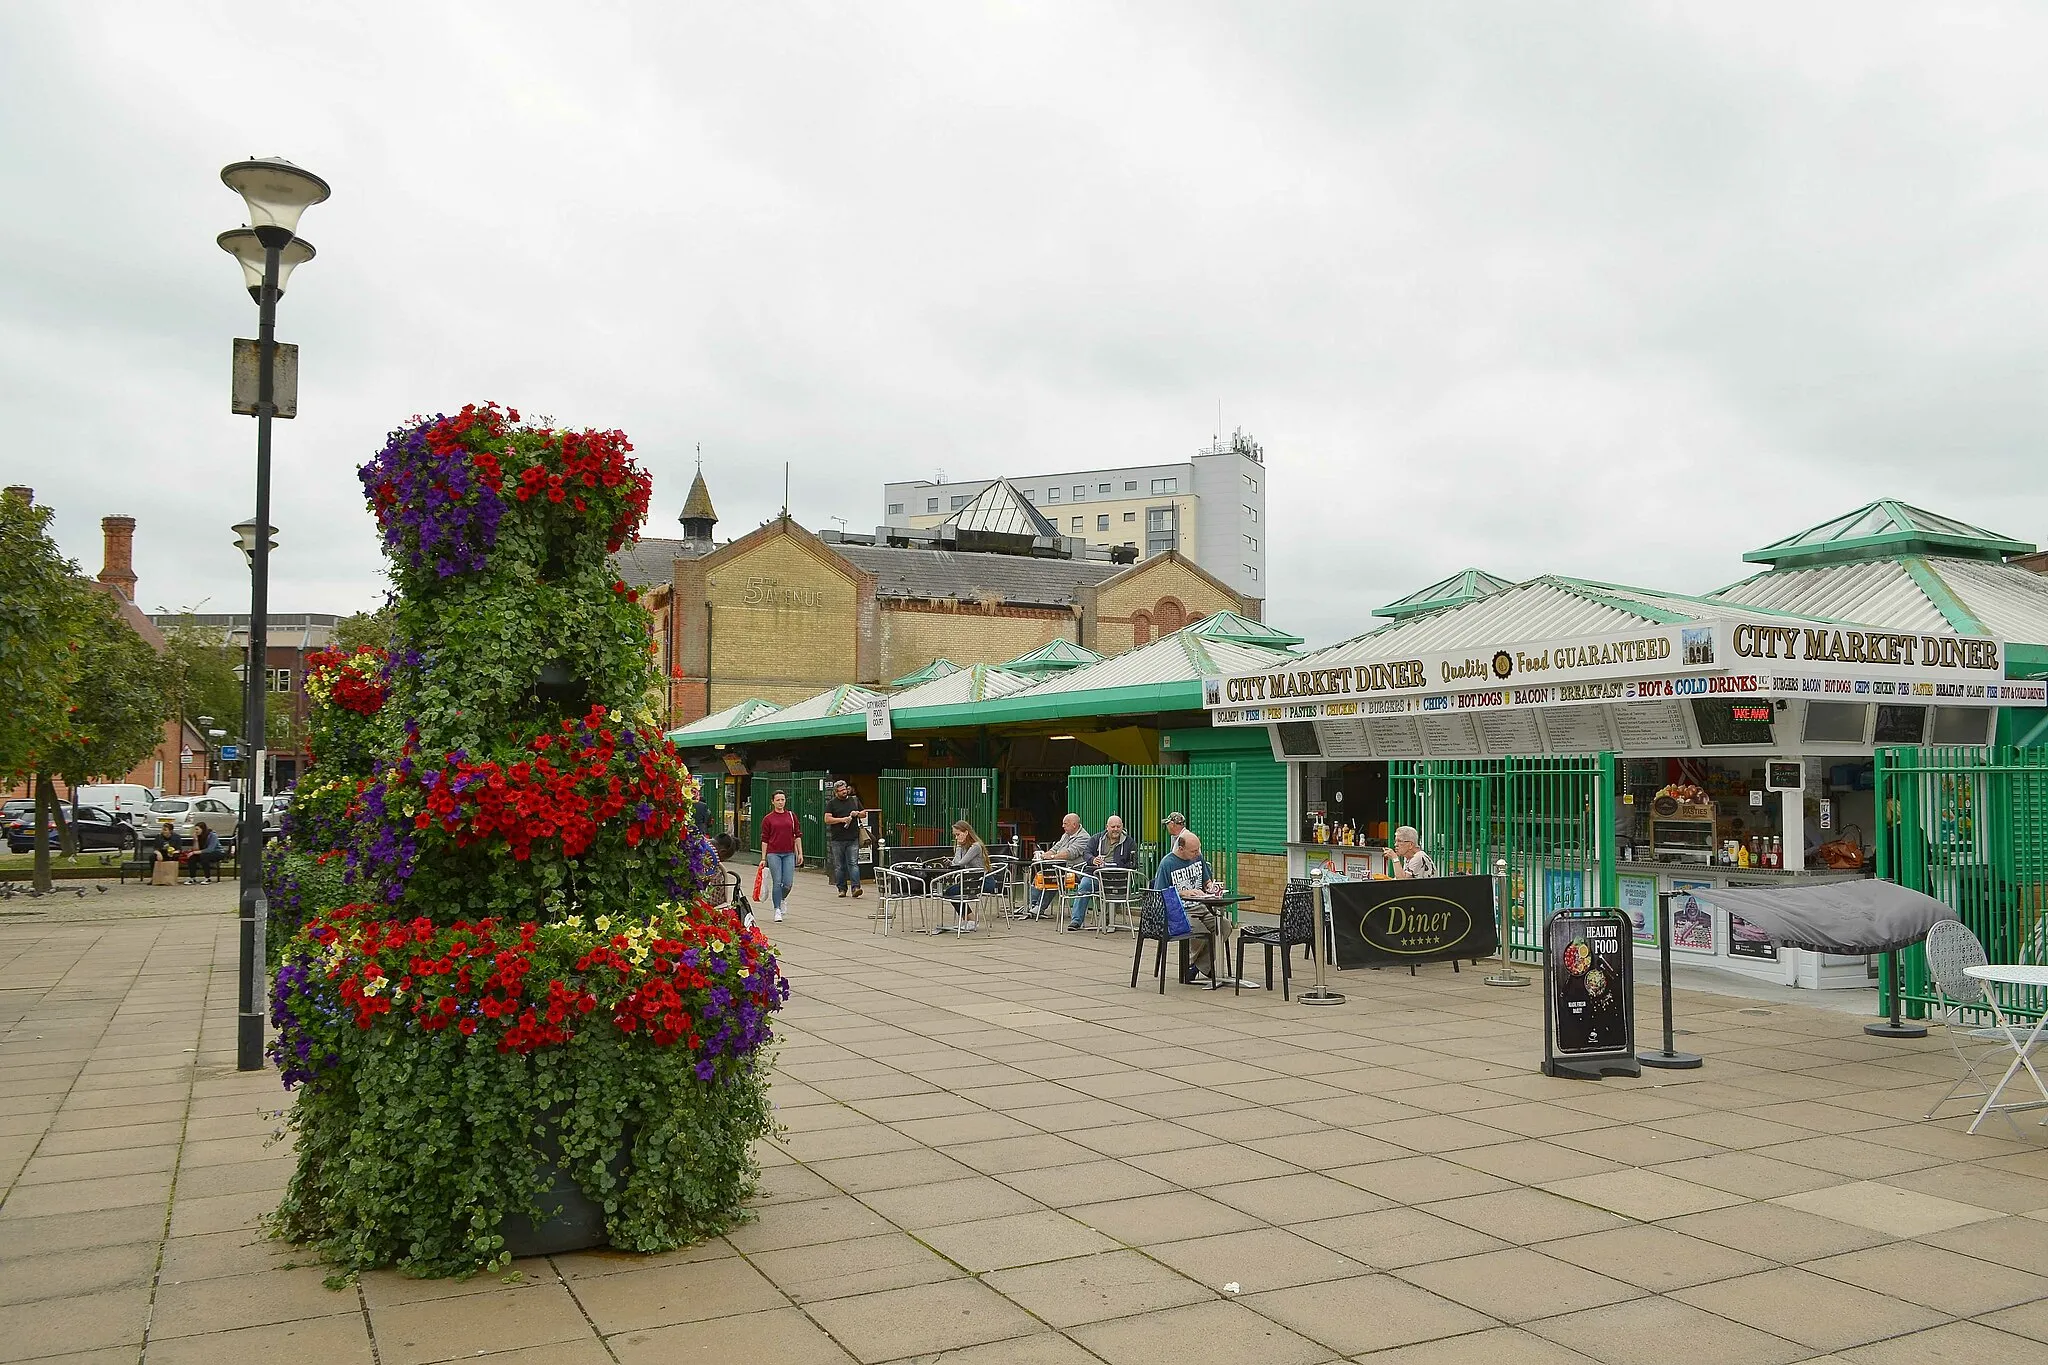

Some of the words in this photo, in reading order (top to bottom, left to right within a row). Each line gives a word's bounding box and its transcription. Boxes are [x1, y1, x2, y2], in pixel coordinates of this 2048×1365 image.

[1733, 623, 1800, 659] CITY
[1804, 628, 1917, 665] MARKET
[1921, 636, 1999, 671] DINER
[1226, 675, 1267, 702] CITY
[1269, 667, 1351, 699] MARKET
[1354, 659, 1426, 693] DINER
[1441, 657, 1489, 683] Quality
[1516, 650, 1550, 673] Food
[1553, 636, 1671, 670] GUARANTEED
[1217, 711, 1239, 722] SCAMPI
[1246, 709, 1260, 721] FISH
[1267, 708, 1282, 720] PIES
[1289, 705, 1317, 718] PASTIES
[1326, 702, 1358, 716] CHICKEN
[1368, 700, 1405, 714] BURGERS
[1423, 696, 1448, 710] CHIPS
[1458, 693, 1477, 708] HOT
[1478, 691, 1502, 707] DOGS
[1514, 688, 1549, 705] BACON
[1560, 682, 1624, 701] BREAKFAST
[1638, 681, 1662, 697] HOT
[1664, 679, 1674, 696] &
[1674, 677, 1708, 695] COLD
[1708, 675, 1758, 693] DRINKS
[1773, 676, 1799, 691] BURGERS
[1802, 679, 1821, 692] BACON
[1824, 680, 1836, 693] HOT
[1836, 680, 1852, 694] DOGS
[1855, 680, 1870, 694] CHIPS
[1872, 681, 1896, 694] CHICKEN
[1898, 682, 1910, 695] PIES
[1912, 683, 1934, 696] PASTIES
[1936, 684, 1964, 697] BREAKFAST
[1966, 686, 1984, 698] SCAMPI
[1987, 686, 1998, 698] FISH
[2000, 686, 2010, 698] HOT
[2015, 687, 2027, 699] COLD
[2028, 688, 2045, 700] DRINKS
[1732, 708, 1750, 719] TAKE
[1750, 708, 1769, 720] AWAY
[1386, 906, 1451, 935] Diner
[1586, 926, 1618, 938] HEALTHY
[1594, 940, 1618, 954] FOOD
